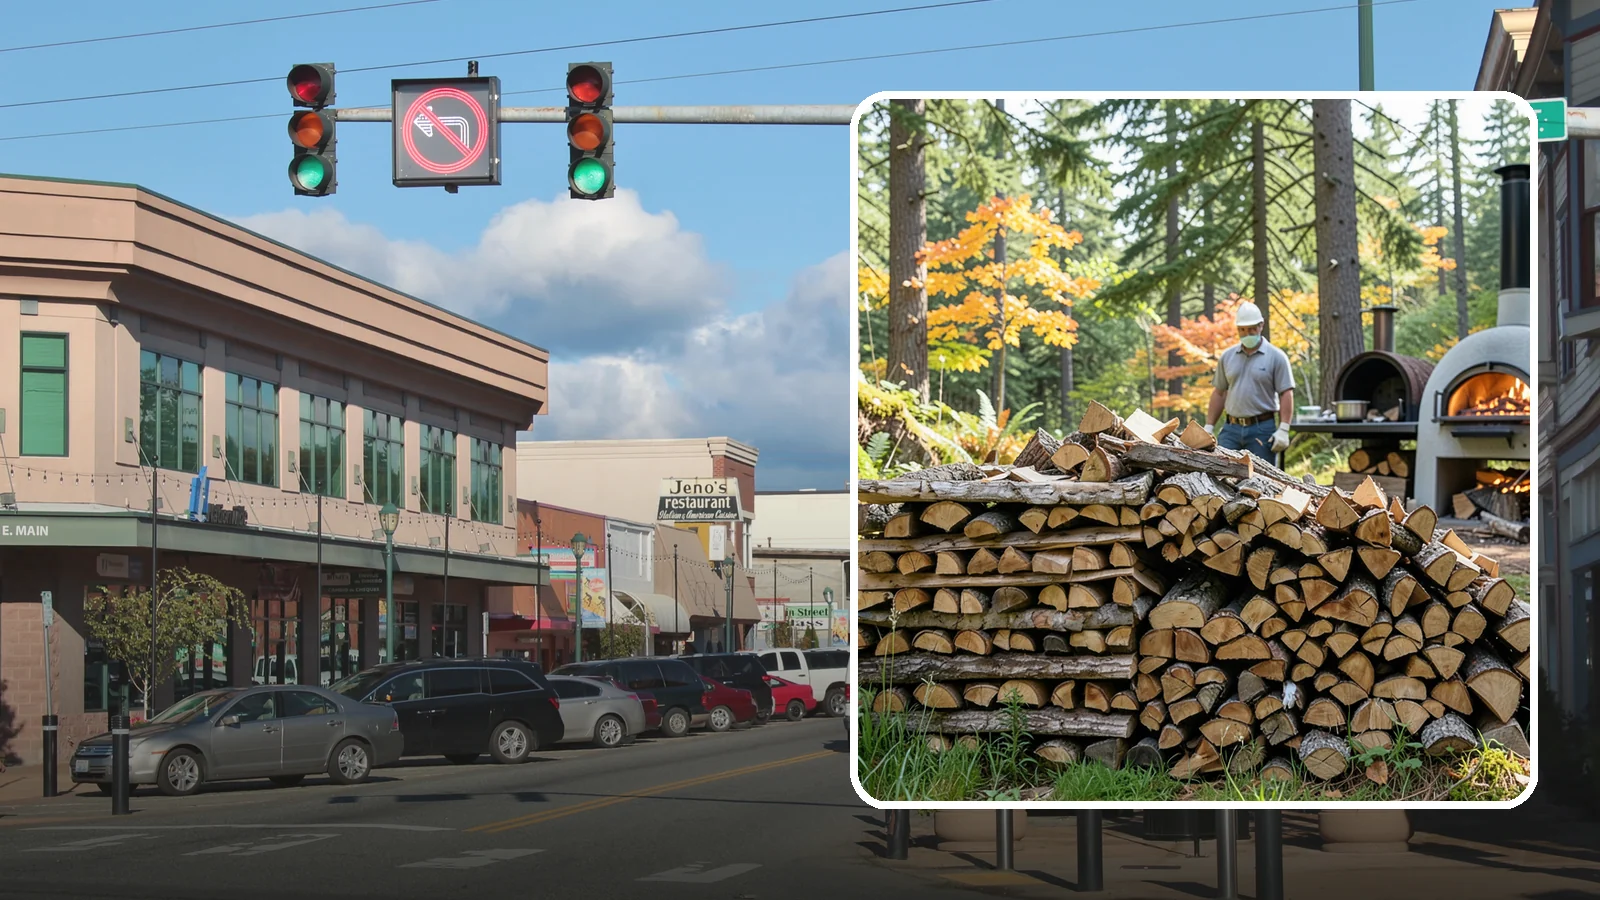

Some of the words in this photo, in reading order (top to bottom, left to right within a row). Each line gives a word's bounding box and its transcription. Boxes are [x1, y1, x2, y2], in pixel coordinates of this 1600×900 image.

[670, 480, 727, 494] Jeno's
[665, 497, 731, 509] restaurant
[686, 509, 714, 519] American
[715, 509, 737, 519] Cuisine
[2, 525, 13, 536] E.
[15, 525, 49, 536] MAIN
[797, 607, 828, 617] Street
